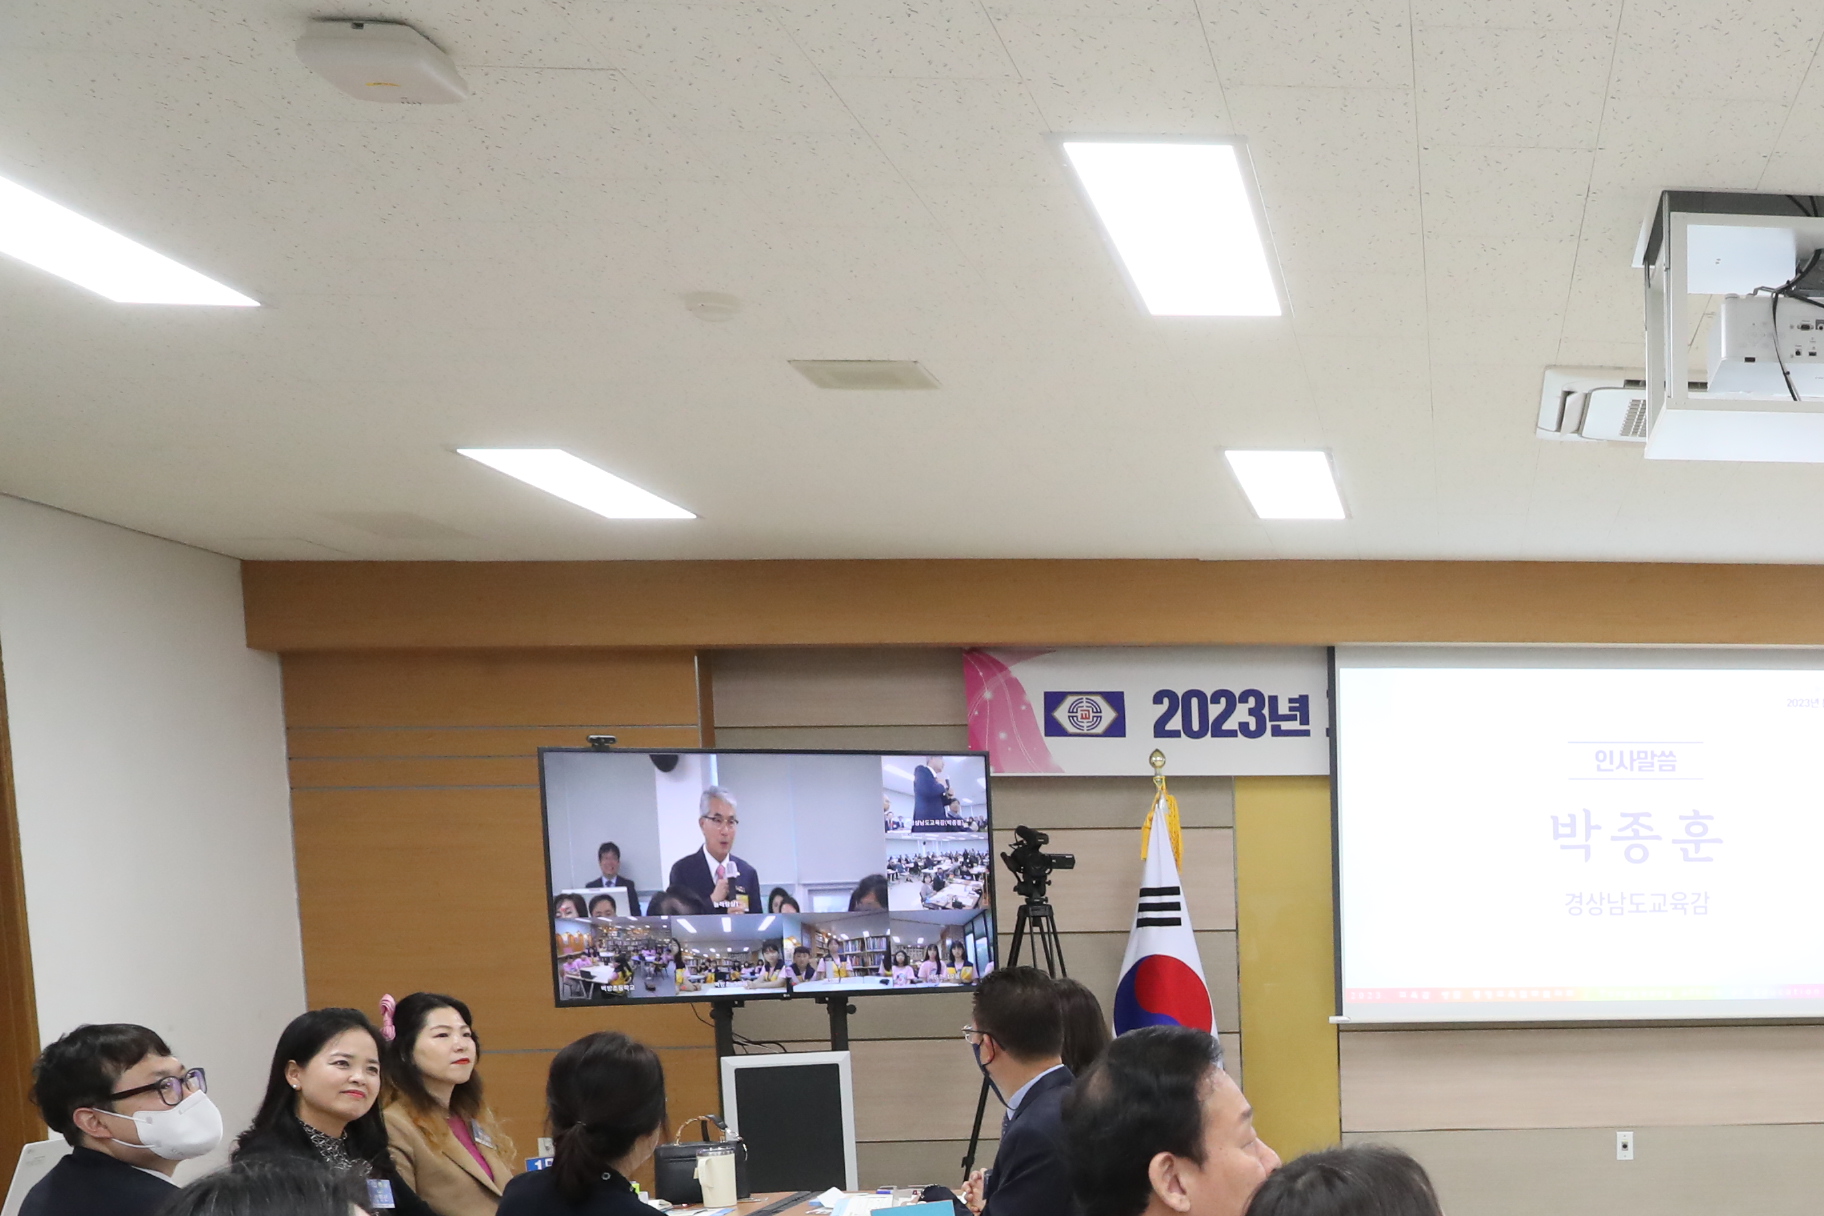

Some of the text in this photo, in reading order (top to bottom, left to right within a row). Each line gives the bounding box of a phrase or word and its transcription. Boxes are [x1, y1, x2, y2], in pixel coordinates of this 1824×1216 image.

[1152, 688, 1311, 740] 2023년
[1594, 749, 1678, 773] 인사말씀
[1564, 890, 1710, 916] 경상남도교육감
